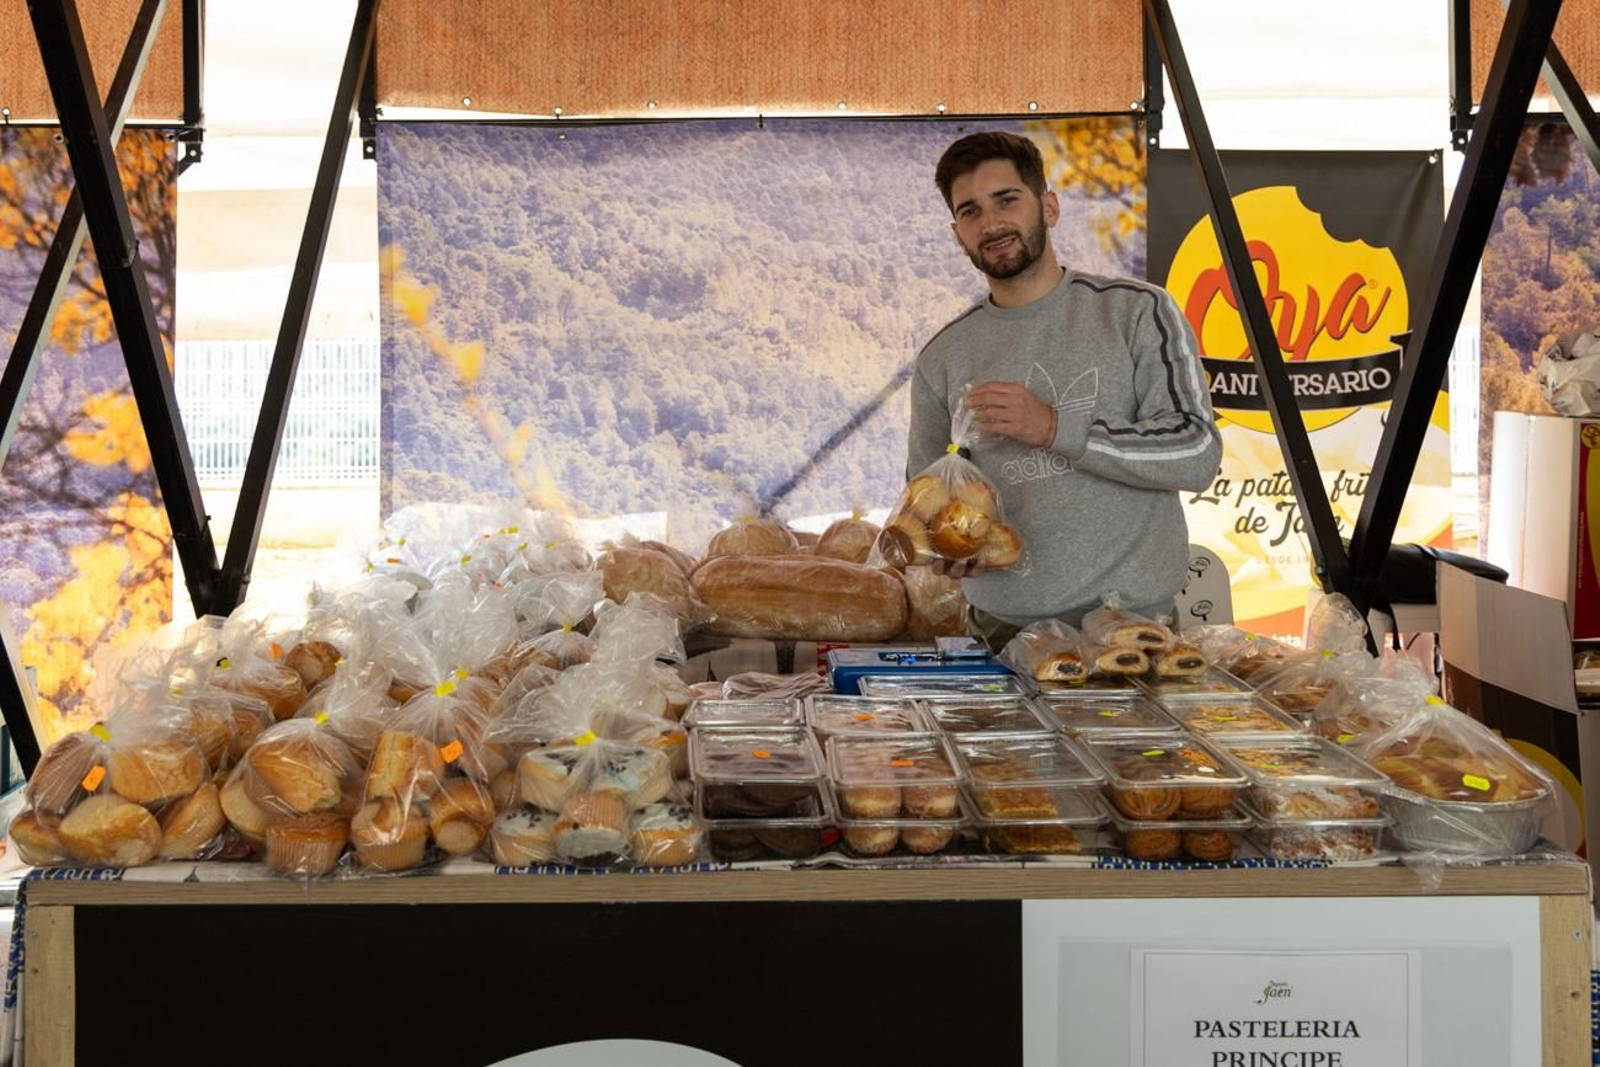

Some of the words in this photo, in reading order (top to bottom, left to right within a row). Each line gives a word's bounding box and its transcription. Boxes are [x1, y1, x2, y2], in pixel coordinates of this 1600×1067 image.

[1210, 367, 1391, 397] ANIRSARIO
[1235, 470, 1297, 508] pata
[1330, 469, 1372, 502] fri
[1235, 506, 1269, 534] de
[1270, 501, 1345, 547] Jan
[1193, 1019, 1361, 1039] PASTELERIA
[1211, 1051, 1343, 1067] PRINCIPE
